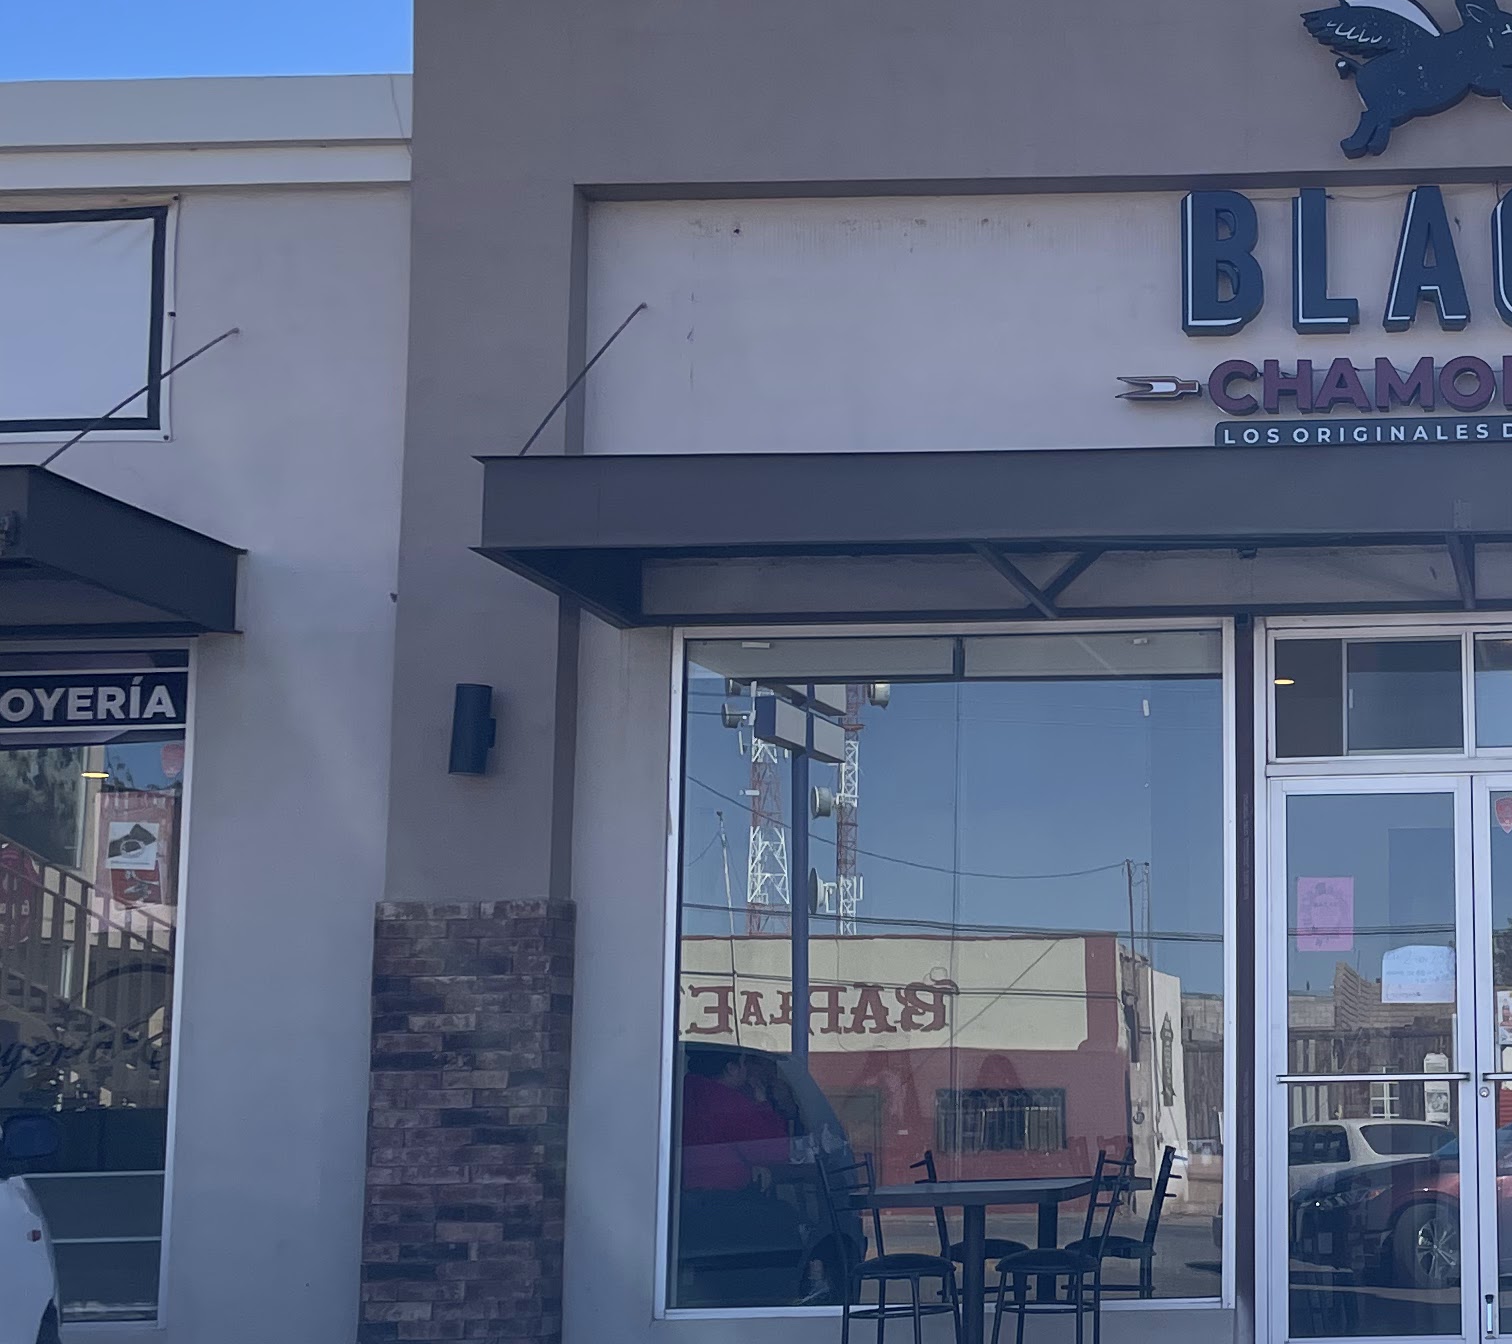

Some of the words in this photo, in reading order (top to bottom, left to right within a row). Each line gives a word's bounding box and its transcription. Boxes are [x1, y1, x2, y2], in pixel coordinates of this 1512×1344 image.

[1223, 427, 1281, 444] LOS
[1292, 422, 1489, 444] ORIGINALES
[0, 675, 177, 722] OYERÍA
